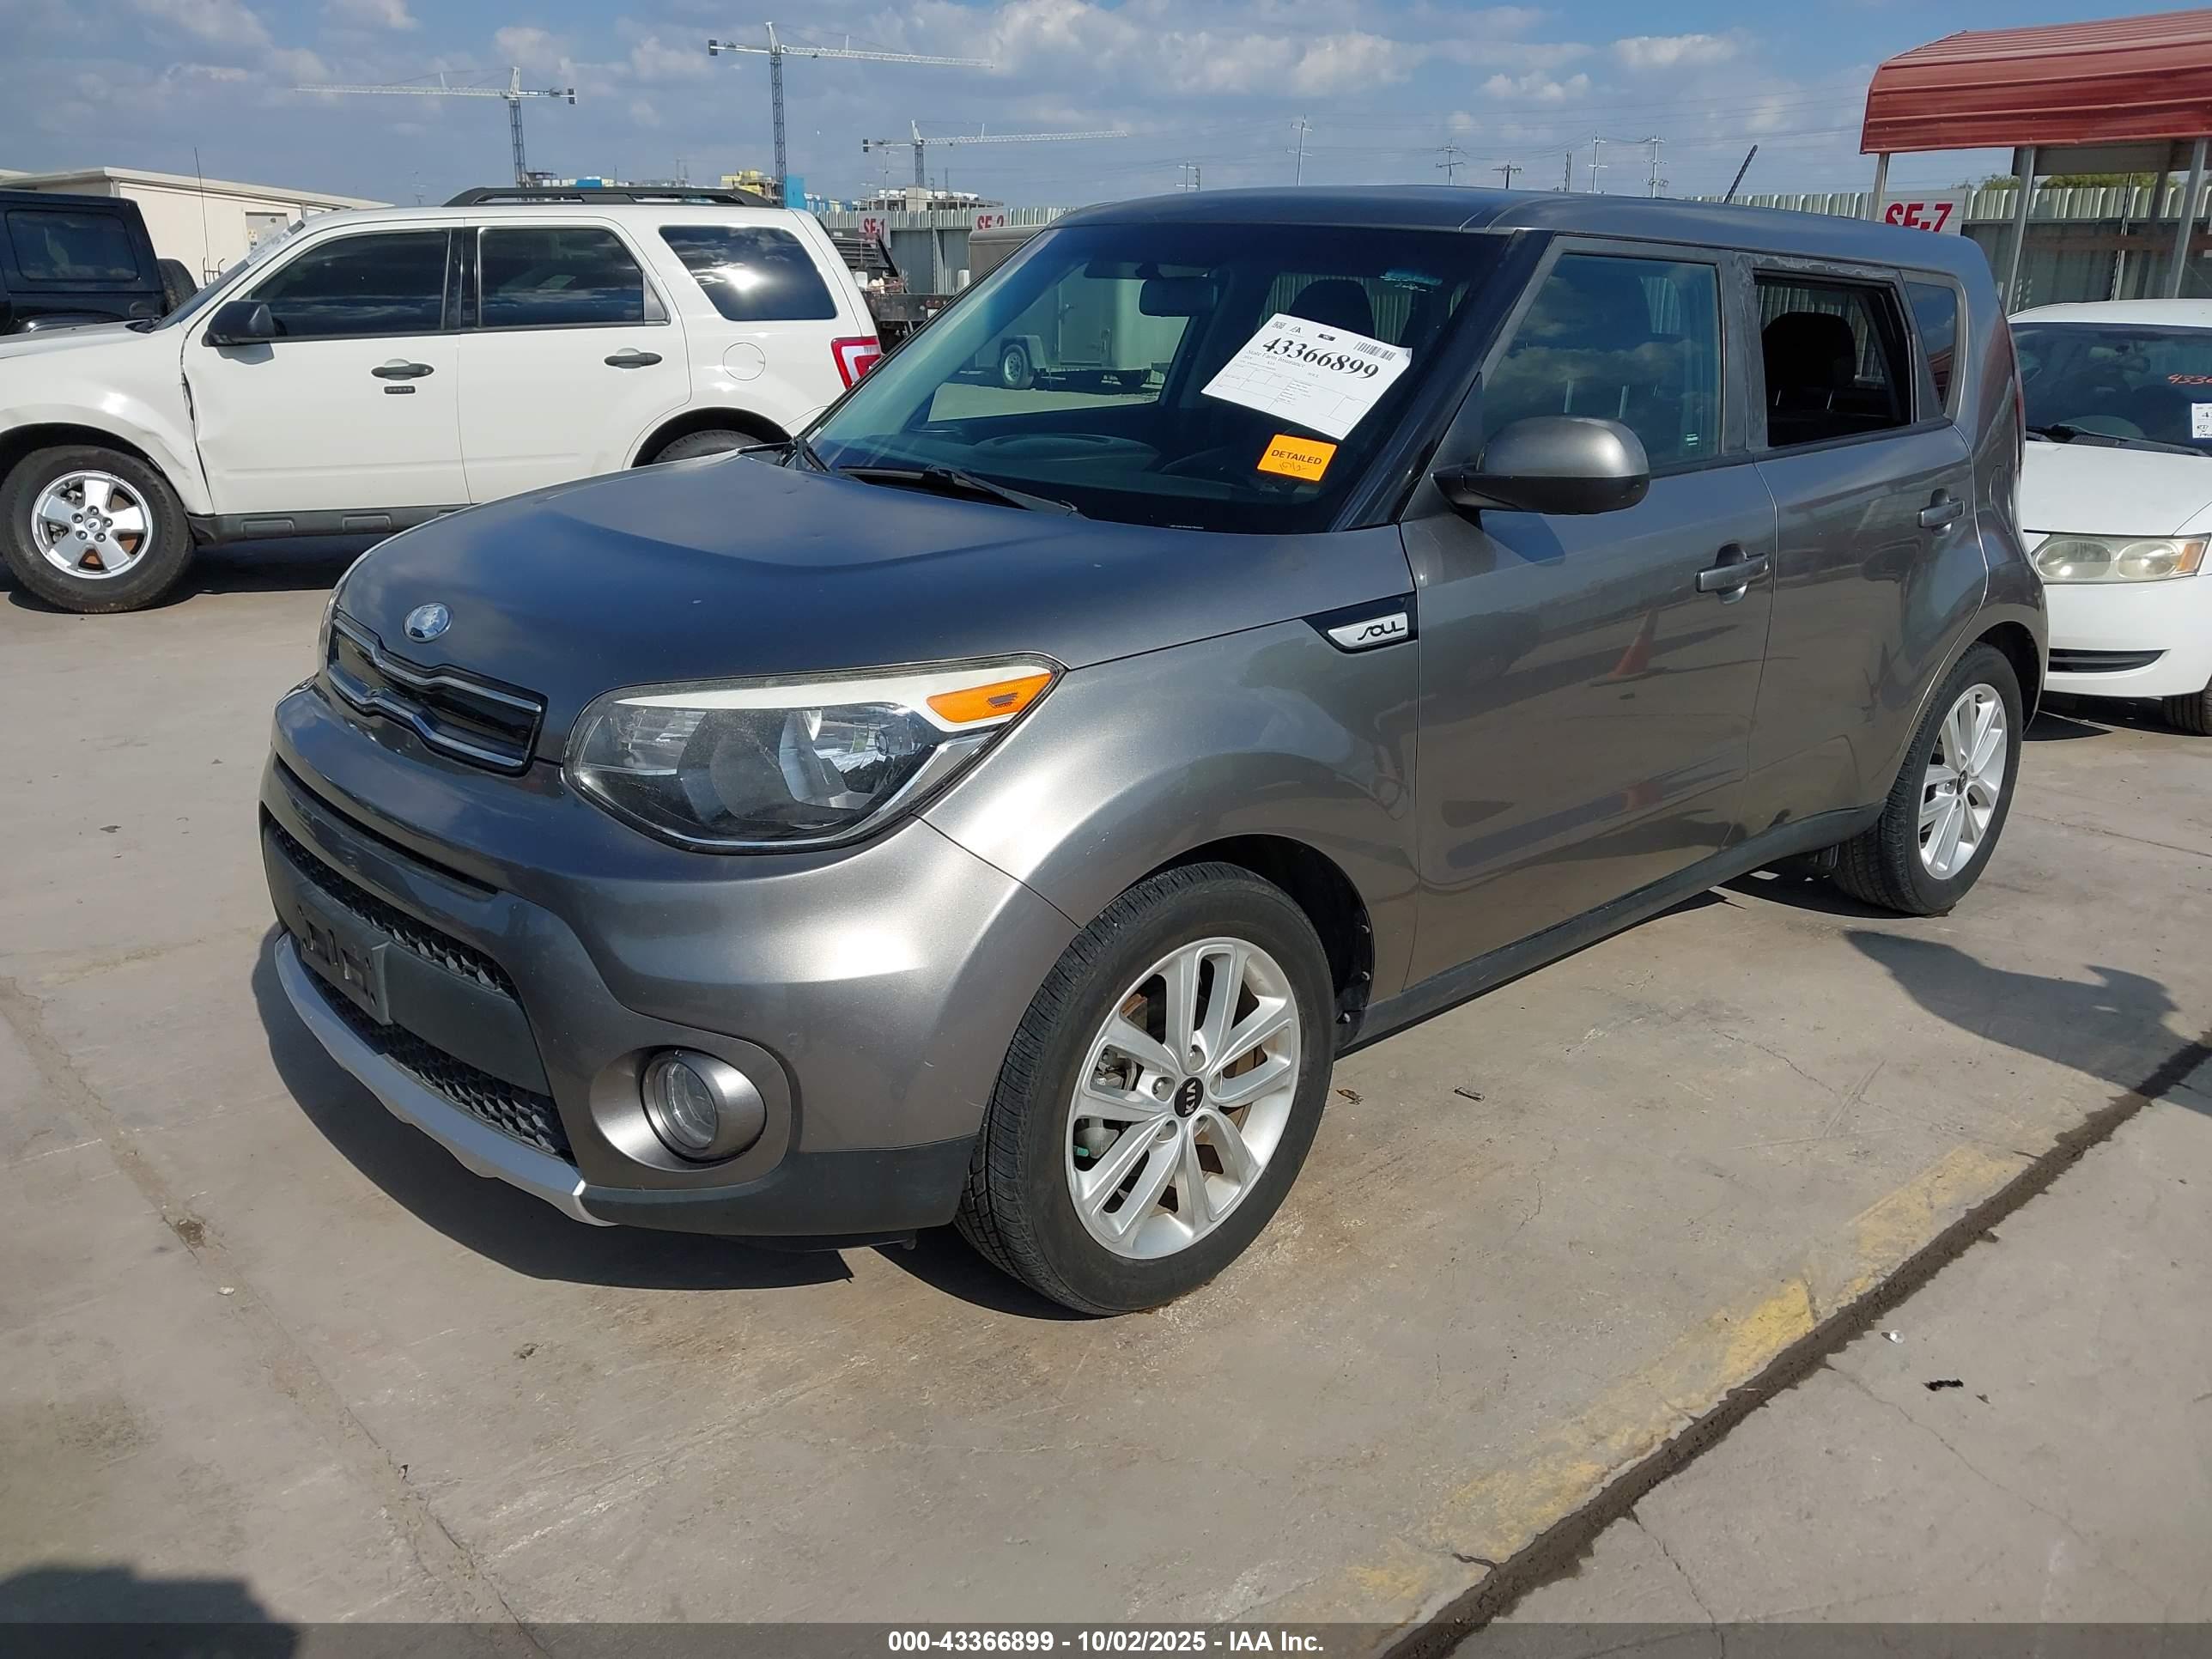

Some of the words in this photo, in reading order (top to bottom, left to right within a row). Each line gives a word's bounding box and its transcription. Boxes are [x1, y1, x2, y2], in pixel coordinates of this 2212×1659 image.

[1262, 337, 1379, 380] 43366899
[1278, 356, 1306, 368] Insurance
[1271, 449, 1322, 465] DETAILED
[1357, 621, 1405, 641] SOUL
[1184, 1080, 1196, 1115] KIA
